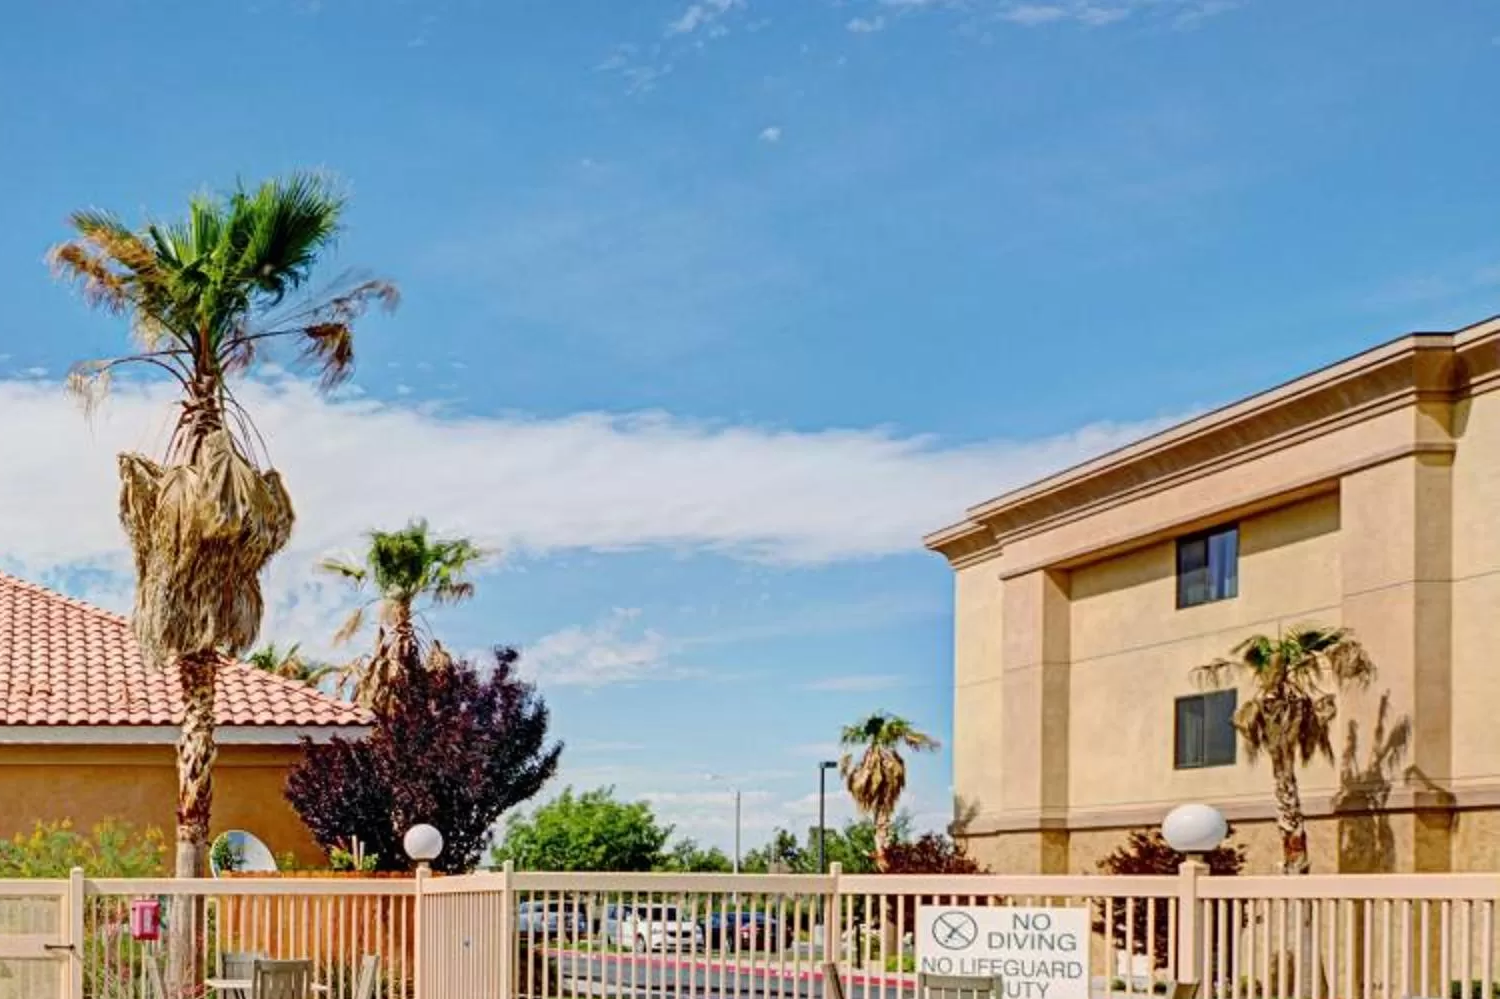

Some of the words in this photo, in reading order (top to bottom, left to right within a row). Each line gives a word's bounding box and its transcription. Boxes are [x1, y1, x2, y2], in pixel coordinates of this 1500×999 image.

[1012, 913, 1051, 931] NO
[987, 931, 1077, 951] DIVING
[921, 956, 953, 974] NO
[960, 957, 1083, 979] LIFEGUARD
[1002, 981, 1050, 999] UTY
